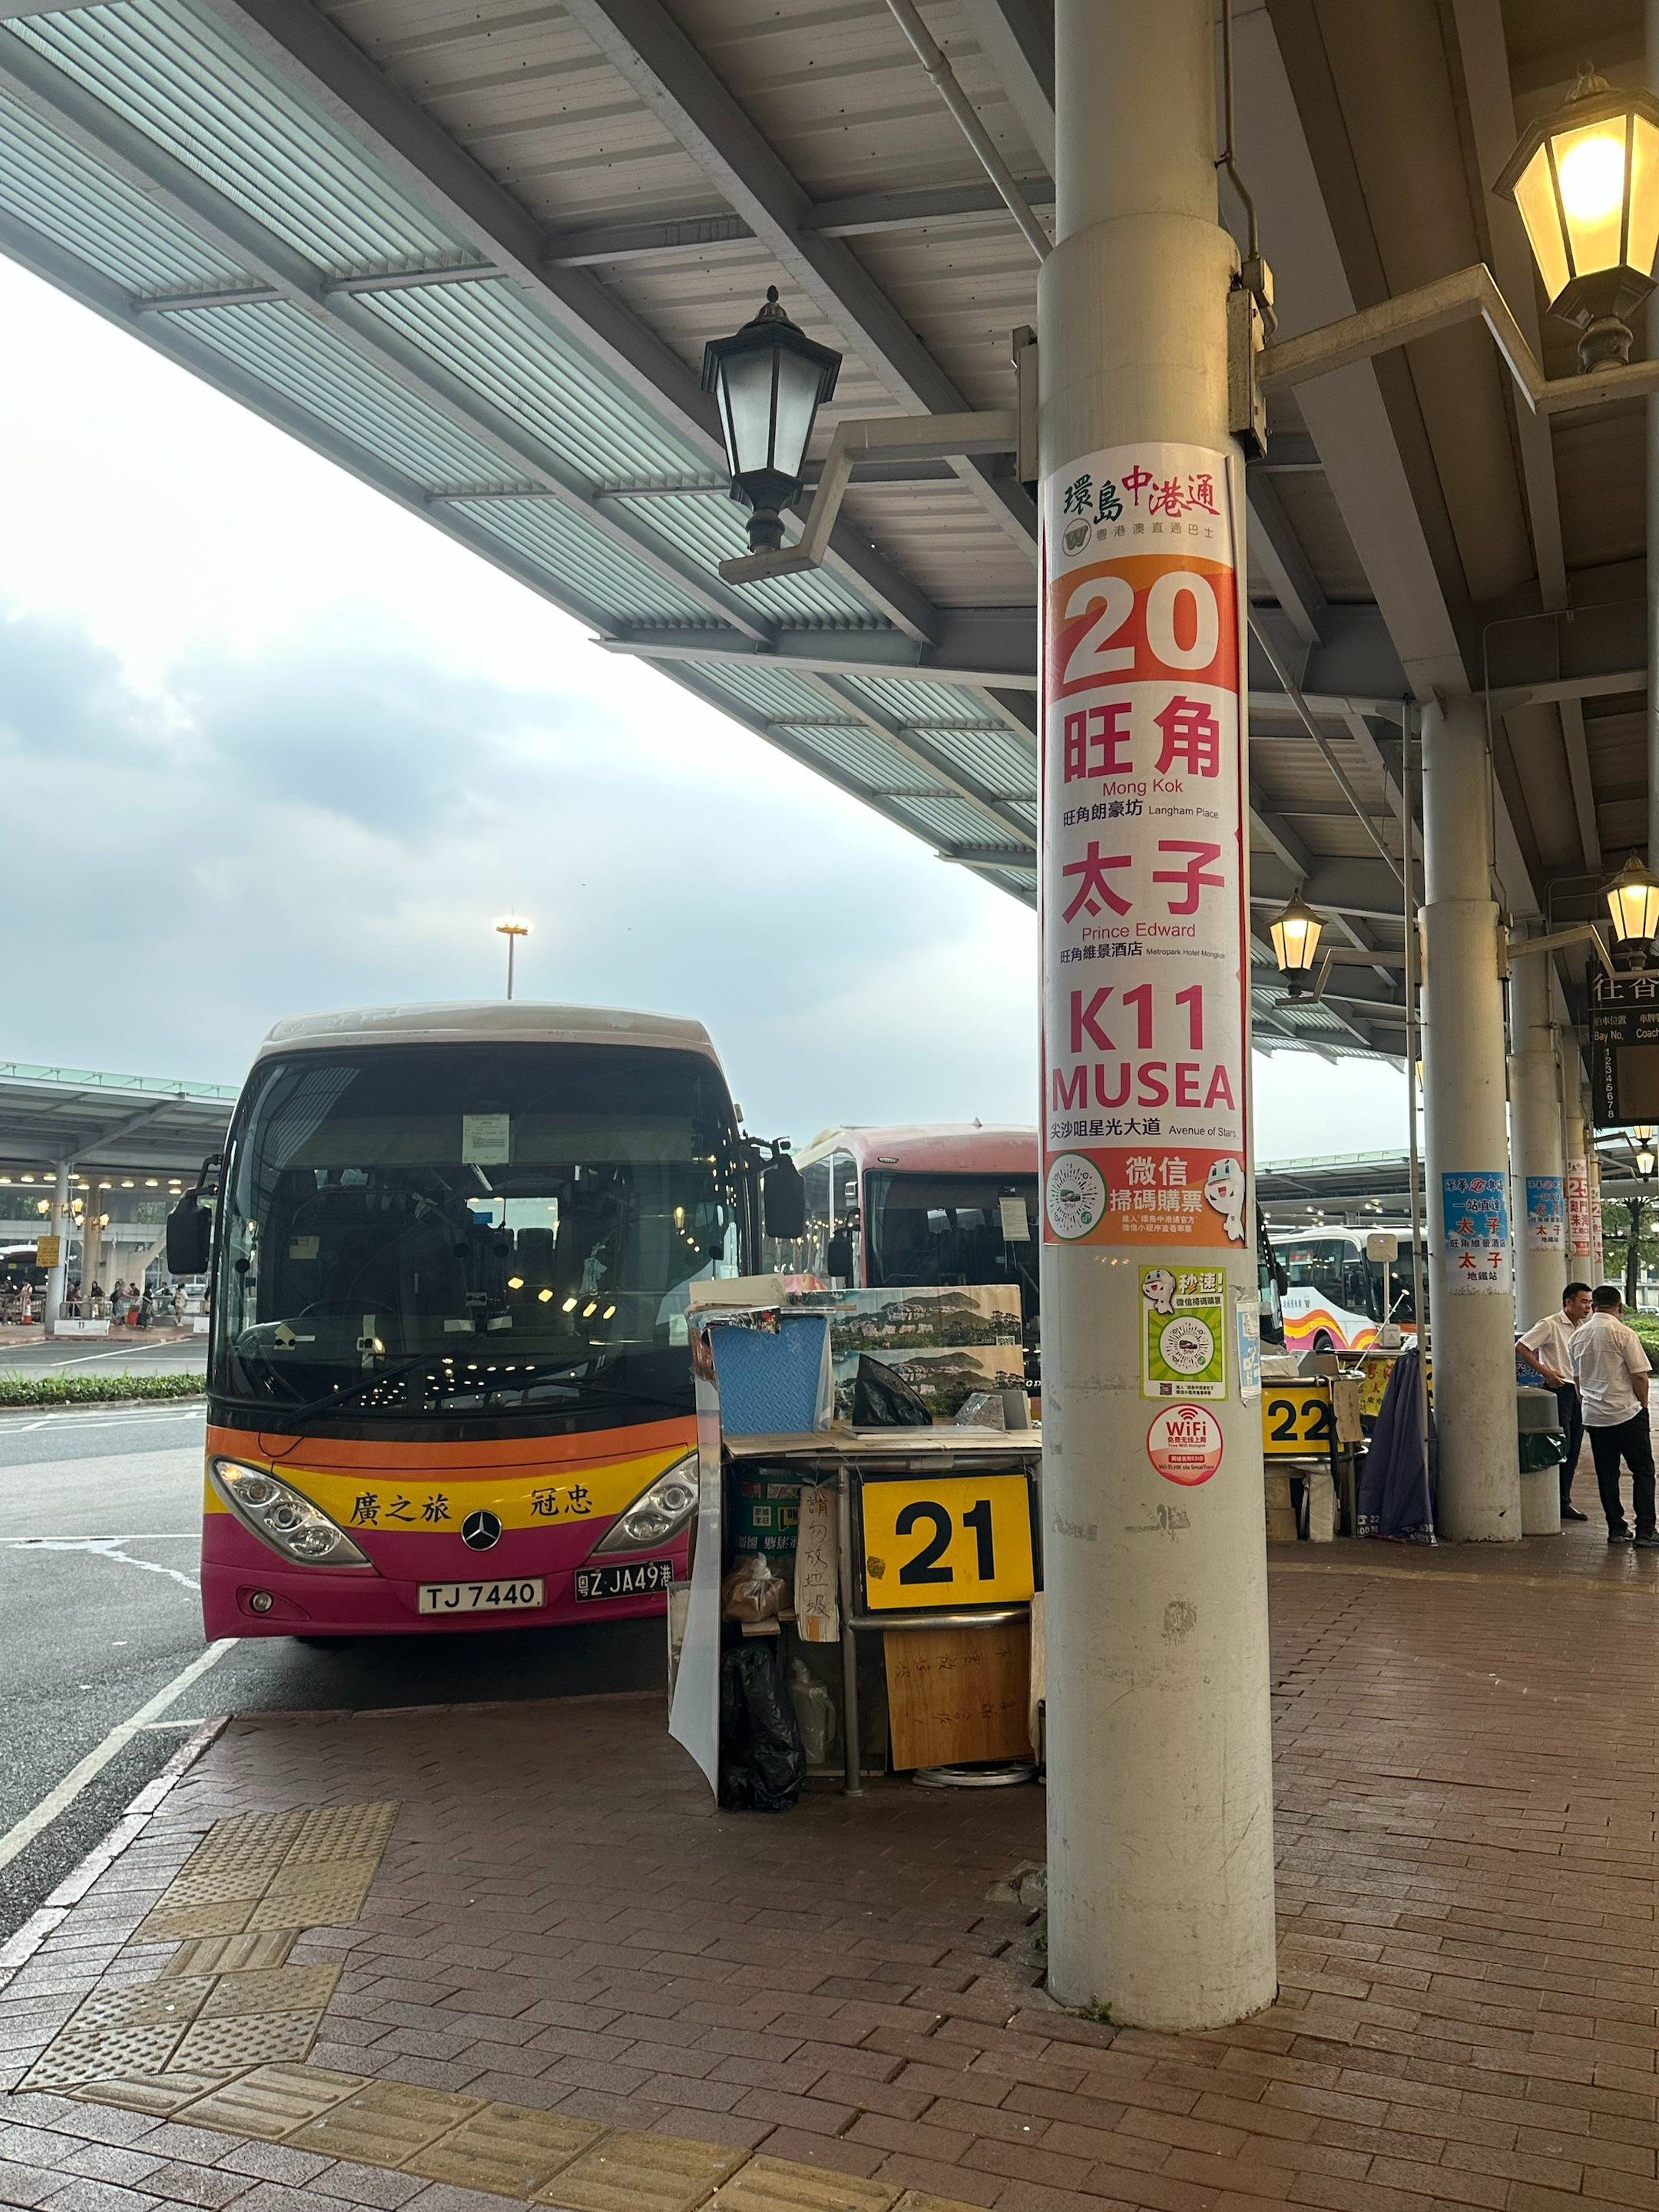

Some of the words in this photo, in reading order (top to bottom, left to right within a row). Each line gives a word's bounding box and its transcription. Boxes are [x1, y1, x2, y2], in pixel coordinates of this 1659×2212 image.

[1063, 465, 1220, 524] 環島中港通
[1063, 571, 1220, 684] 20
[1064, 695, 1220, 783] 旺角
[1103, 782, 1147, 796] Mong
[1153, 779, 1184, 793] Kok
[1063, 799, 1143, 827] 旺角朗豪坊
[1148, 806, 1194, 816] Langham
[1196, 807, 1219, 819] Place
[1062, 840, 1225, 924] 太子
[1082, 926, 1130, 942] Prince
[1136, 922, 1195, 938] Edward
[1060, 941, 1142, 964] 旺角維景酒店
[1146, 948, 1181, 956] Metropark
[1070, 983, 1203, 1053] K11
[1594, 1031, 1608, 1043] Bay
[1611, 1030, 1624, 1041] No.
[1052, 1061, 1235, 1111] MUSEA
[1051, 1118, 1161, 1140] 尖沙咀星光大道
[1169, 1125, 1204, 1136] Avenue
[1207, 1125, 1216, 1136] of
[1217, 1127, 1237, 1138] Stars
[1125, 1156, 1187, 1186] 微信
[1569, 1180, 1588, 1197] 25
[1110, 1189, 1202, 1213] 掃碼購票
[1457, 1217, 1501, 1234] 太子
[1459, 1252, 1502, 1269] 太子
[1166, 1421, 1207, 1436] WiFi
[1268, 1399, 1330, 1441] 22
[349, 1493, 452, 1526] 廣之旅
[530, 1485, 594, 1517] 冠忠
[895, 1499, 996, 1586] 21
[427, 1588, 461, 1609] TJ
[469, 1582, 535, 1606] 7440
